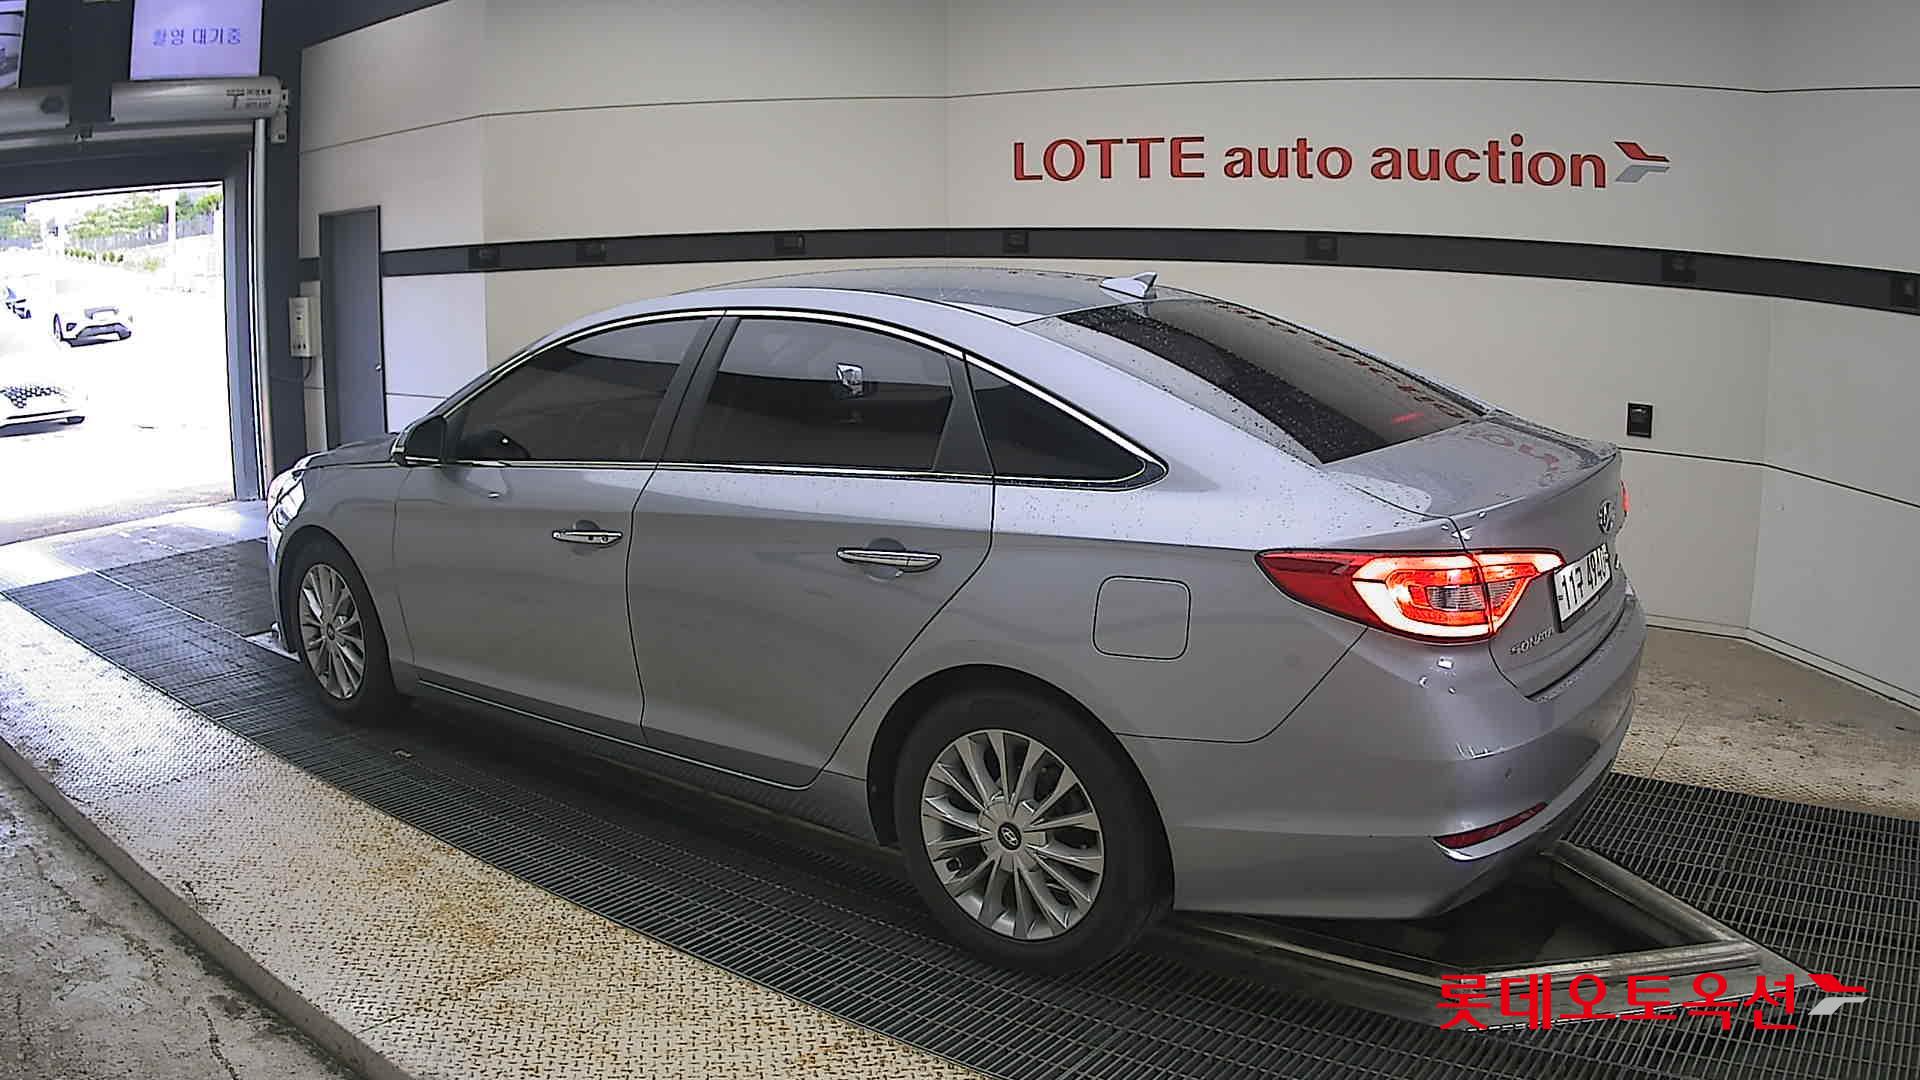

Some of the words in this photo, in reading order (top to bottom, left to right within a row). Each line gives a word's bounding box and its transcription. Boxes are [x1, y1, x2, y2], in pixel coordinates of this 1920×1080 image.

[1013, 136, 1206, 182] LOTTE
[1223, 138, 1353, 179] auto
[1369, 133, 1607, 189] auction
